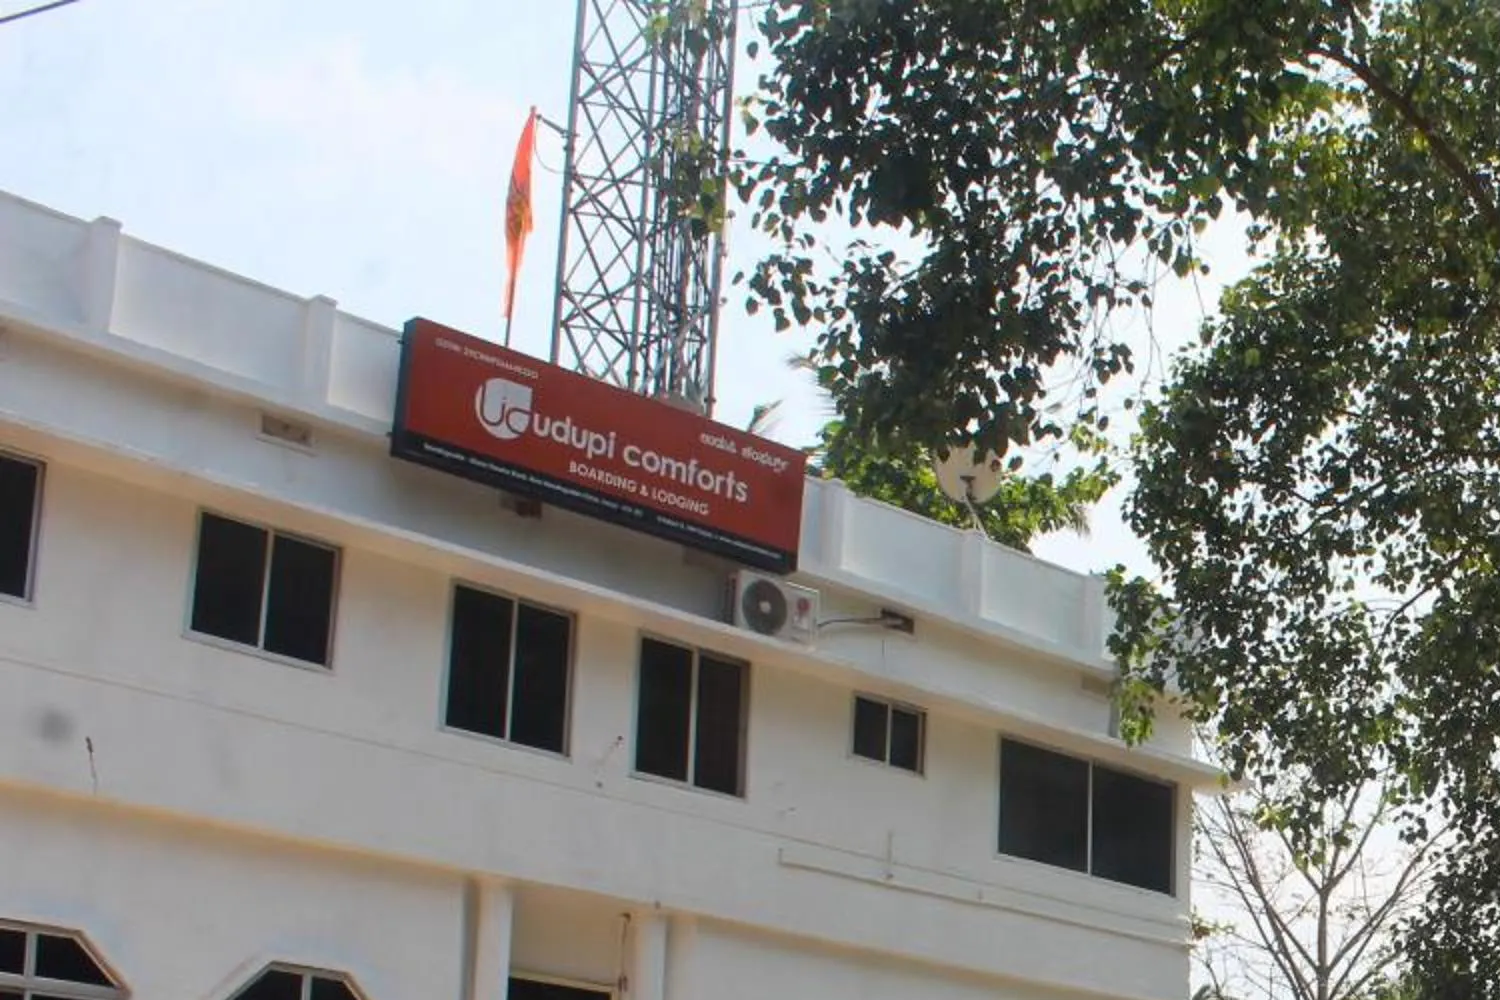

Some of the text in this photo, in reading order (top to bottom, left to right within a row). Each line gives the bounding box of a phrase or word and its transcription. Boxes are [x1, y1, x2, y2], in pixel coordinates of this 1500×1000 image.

[533, 412, 616, 459] udupi
[623, 445, 749, 502] comforts
[569, 460, 638, 493] BOARDING
[652, 486, 709, 515] LODGING
